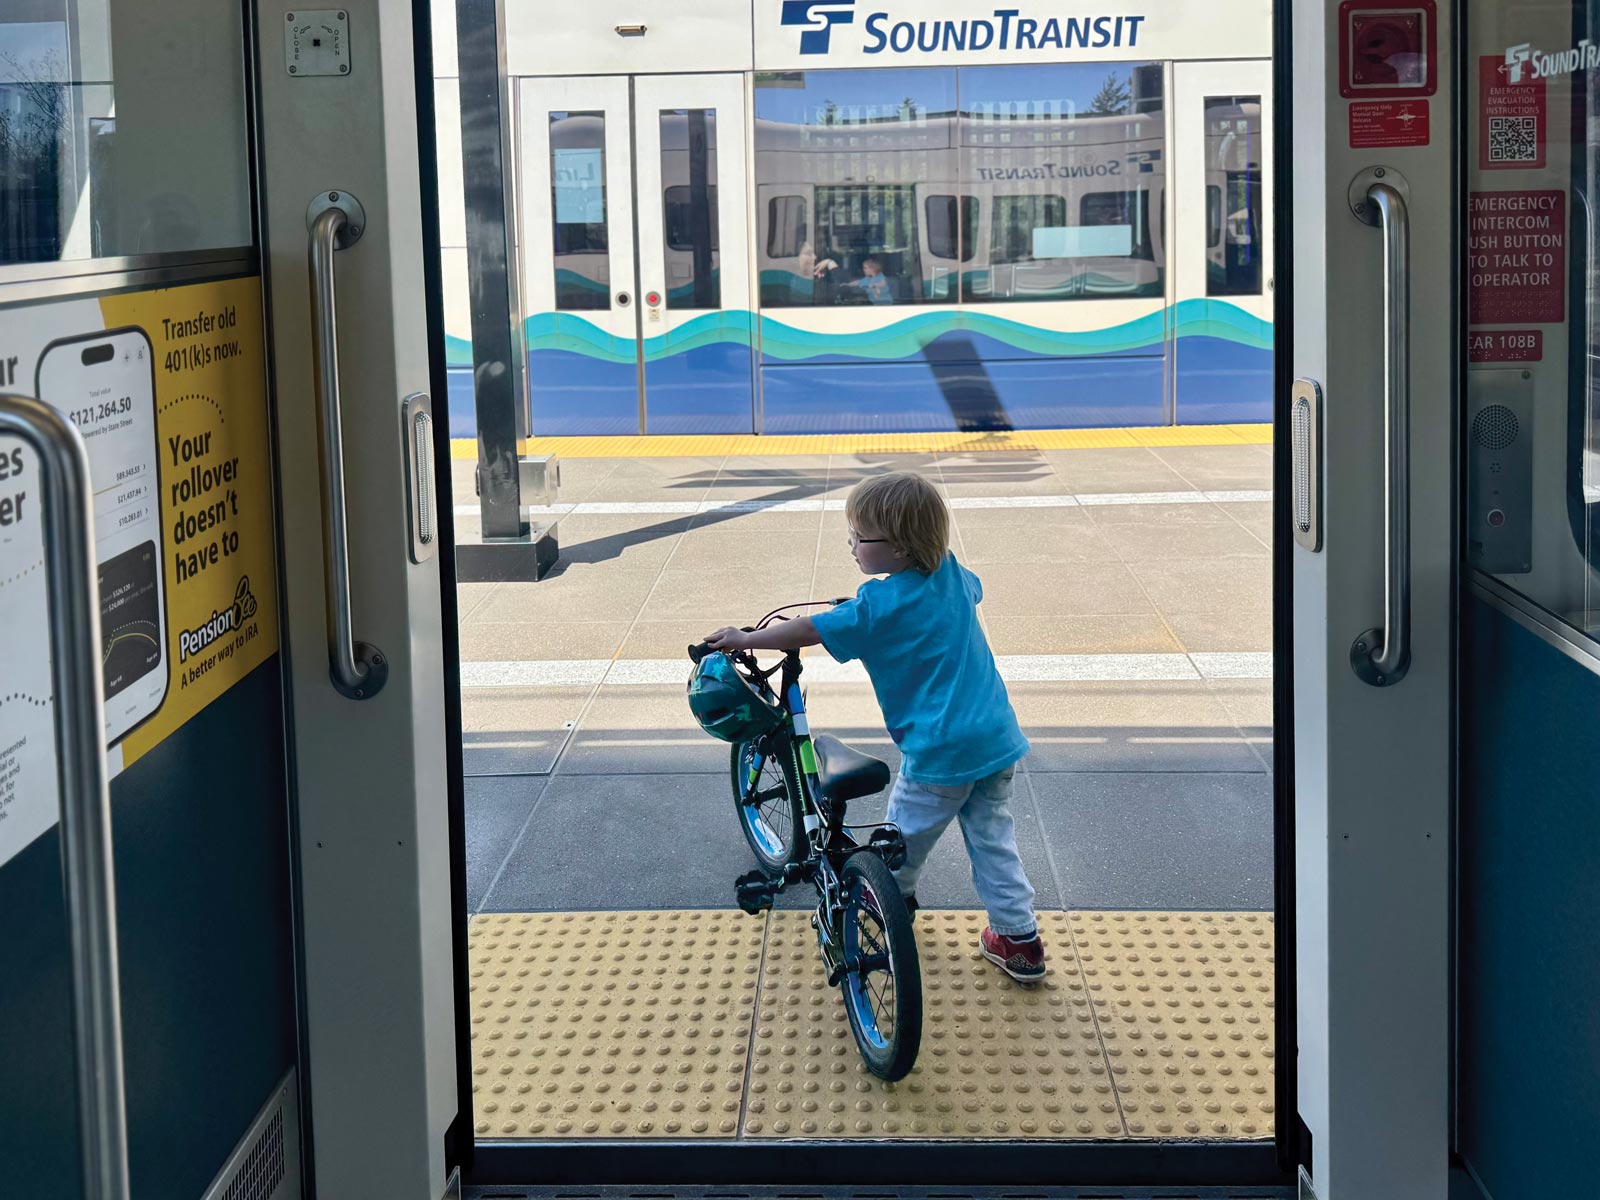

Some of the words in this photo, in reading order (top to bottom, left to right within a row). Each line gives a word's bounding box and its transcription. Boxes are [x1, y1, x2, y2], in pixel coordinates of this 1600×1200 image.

[1488, 96, 1536, 105] EVACUATION
[1490, 87, 1536, 95] EMERGENCY
[1486, 106, 1540, 115] INSTRUCTIONS
[1472, 215, 1550, 230] INTERCOM
[1469, 236, 1498, 249] USH
[1504, 234, 1563, 248] BUTTON
[1469, 255, 1488, 268] TO
[1494, 254, 1529, 267] TALK
[1535, 253, 1553, 267] TO
[1472, 272, 1551, 287] OPERATOR
[162, 311, 216, 341] Transfer
[217, 305, 236, 330] old
[1499, 335, 1536, 349] 108B
[164, 343, 211, 374] 401(k)s
[214, 340, 242, 362] now.
[69, 396, 132, 426] $121,264.50
[168, 431, 211, 467] Your
[171, 456, 239, 507] rollover
[173, 489, 238, 545] doesn't
[175, 541, 218, 585] have
[221, 530, 239, 557] to
[181, 673, 188, 690] A
[189, 654, 217, 684] better
[217, 641, 235, 663] way
[235, 635, 244, 649] to
[245, 622, 259, 644] IRA
